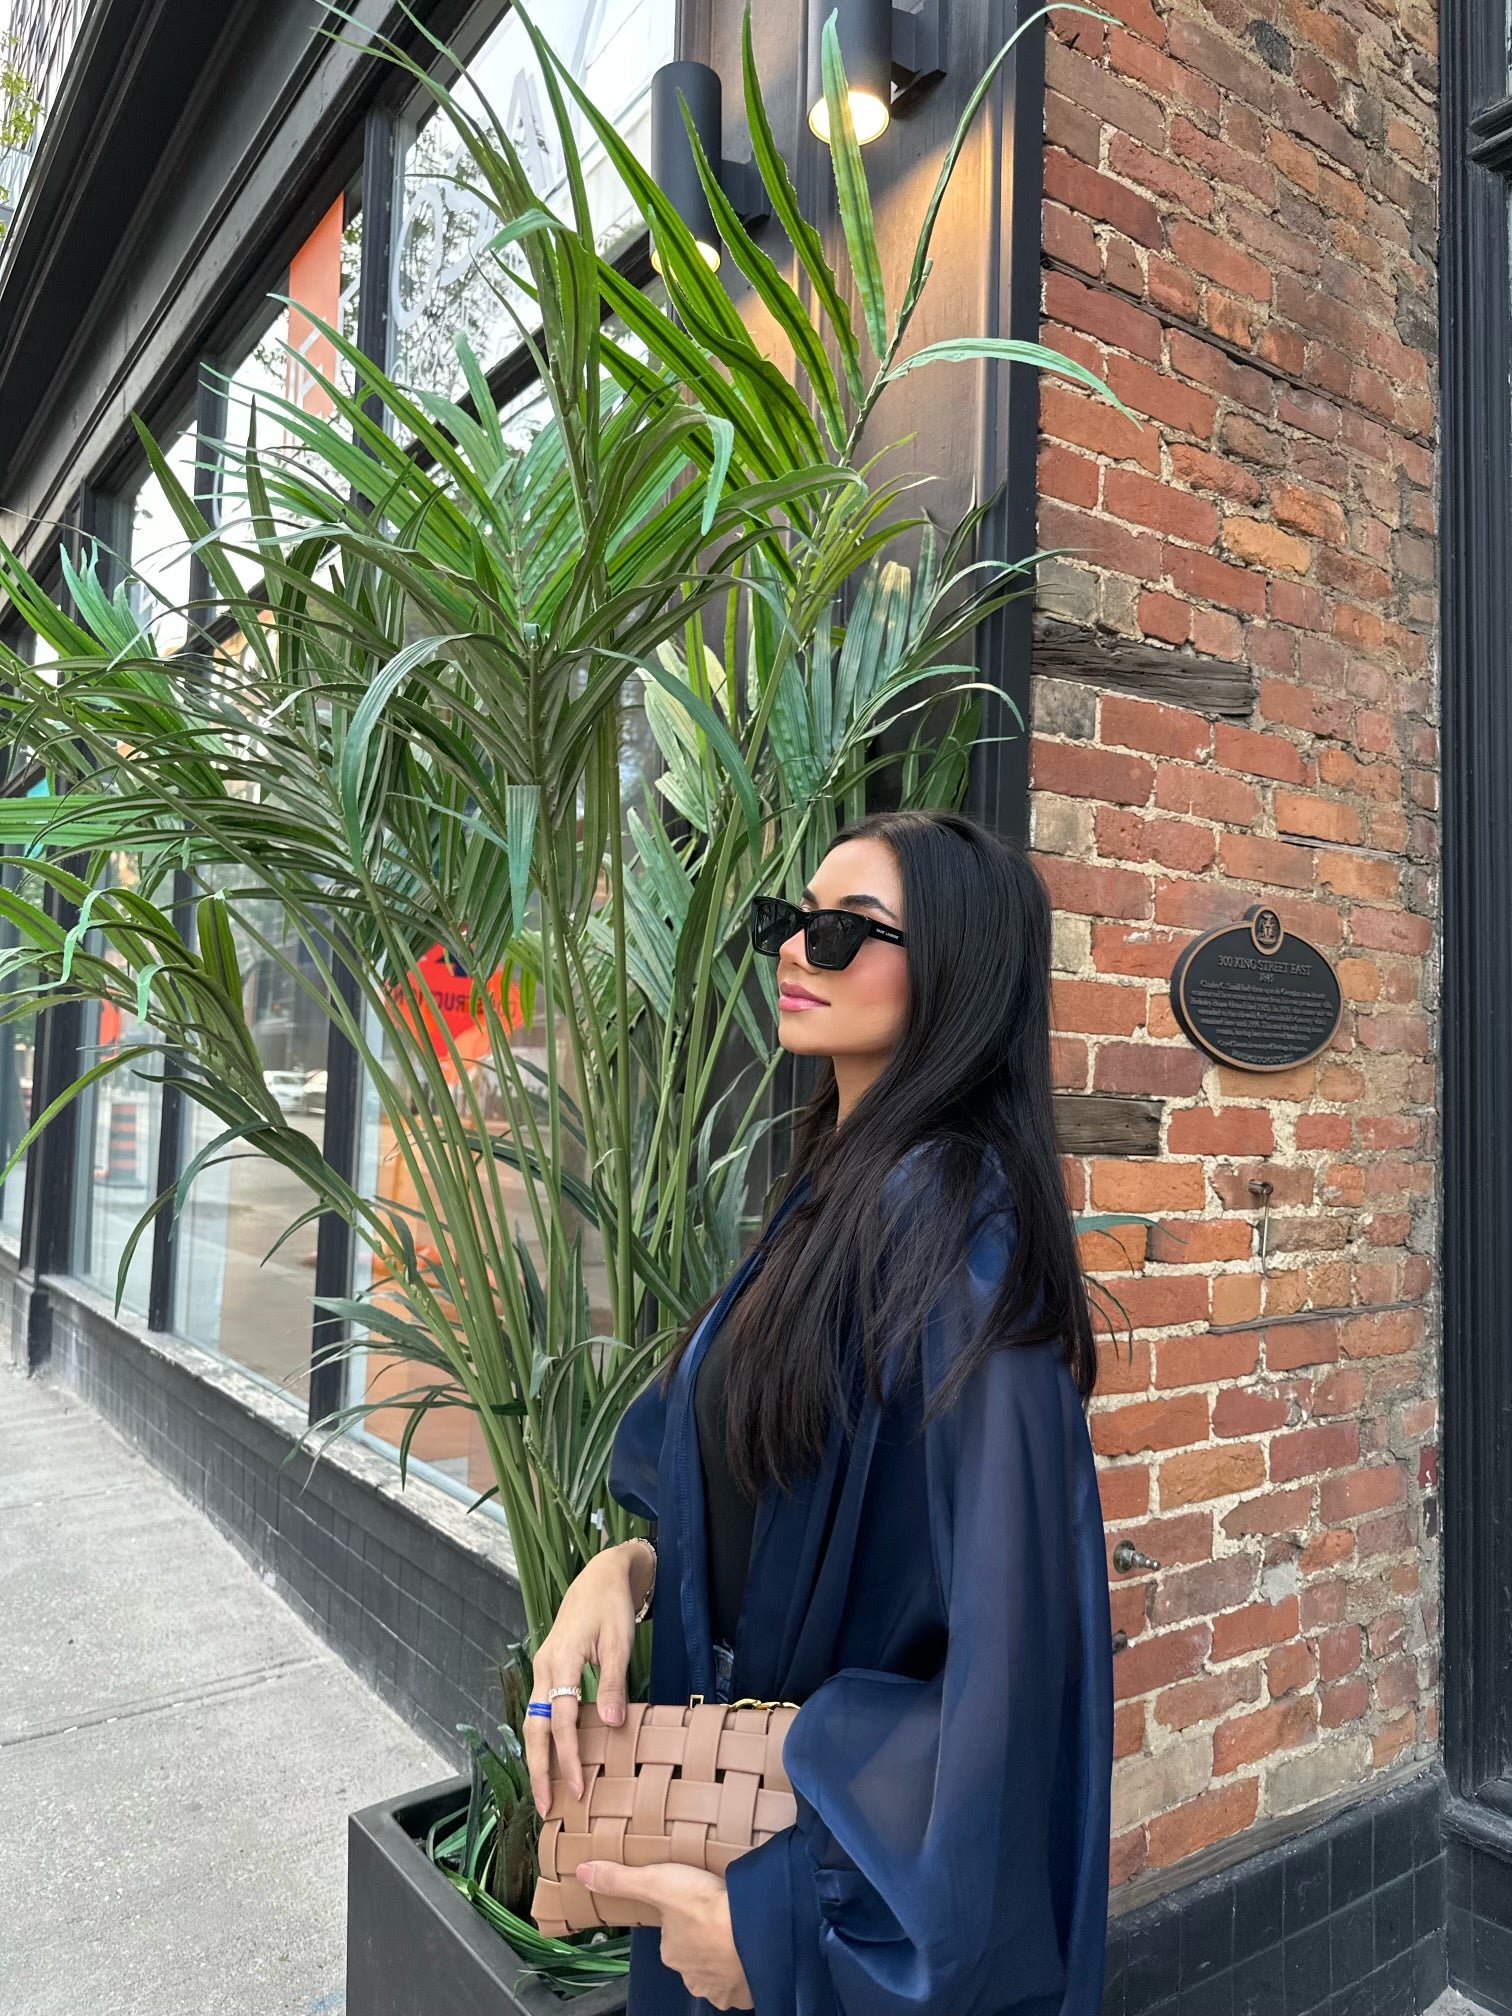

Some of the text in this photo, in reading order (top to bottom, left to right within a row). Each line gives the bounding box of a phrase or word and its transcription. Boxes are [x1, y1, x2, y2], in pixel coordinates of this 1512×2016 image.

[1217, 955, 1313, 976] 300 KING STREET EAST
